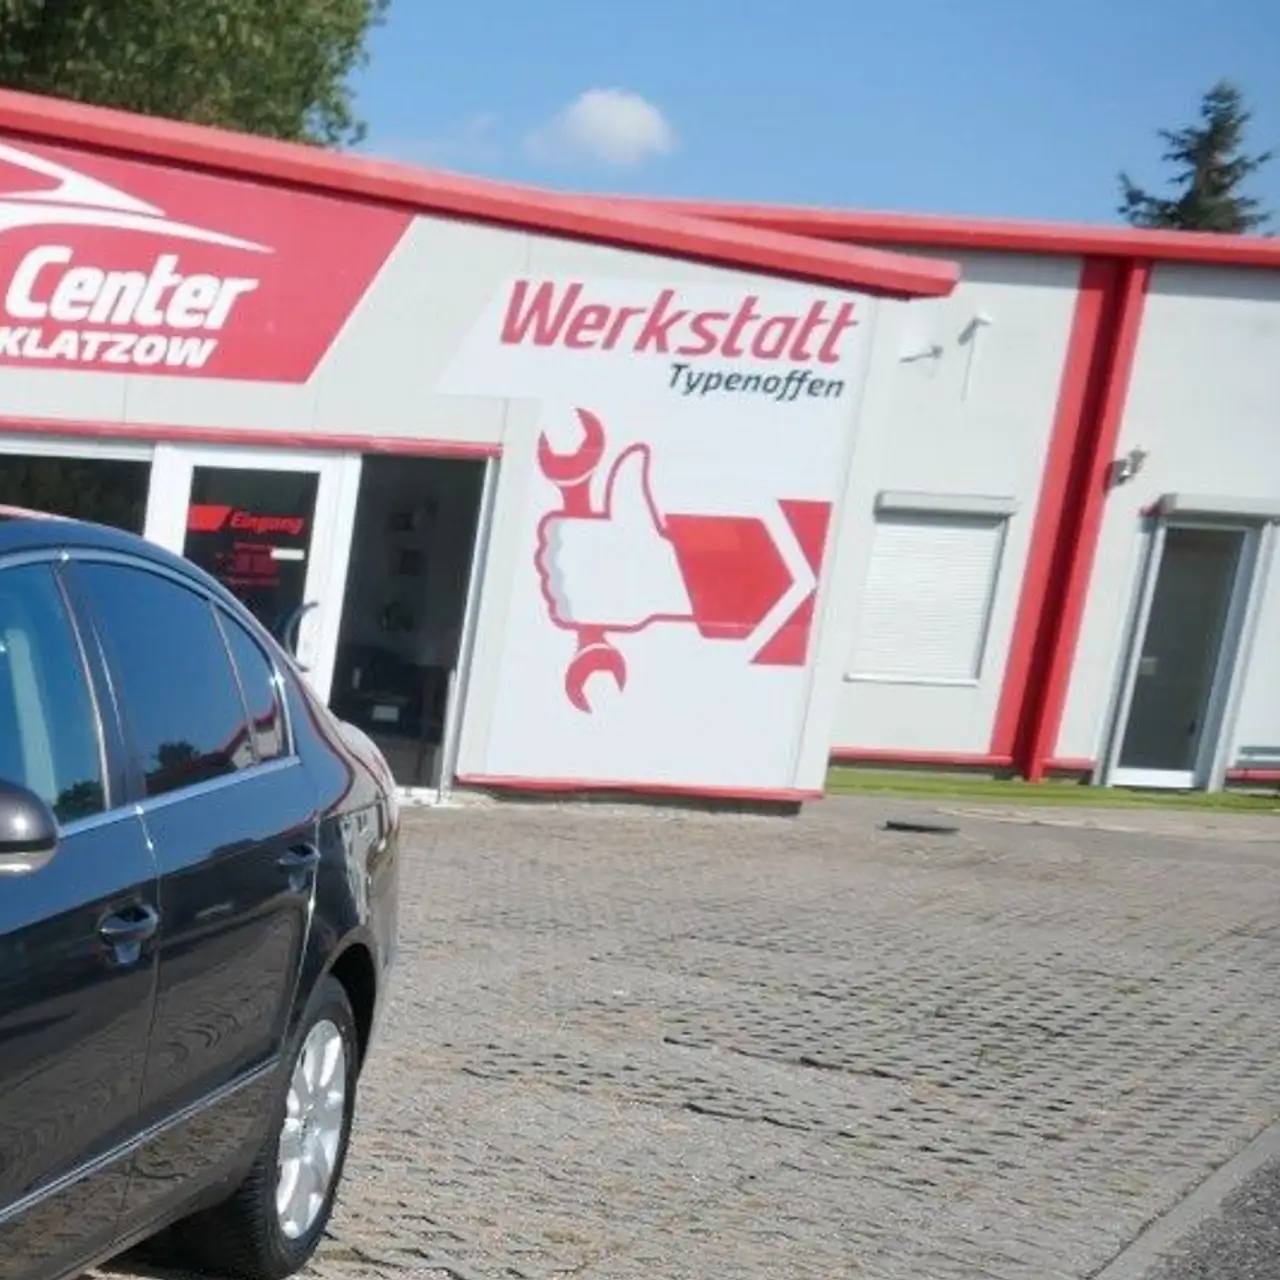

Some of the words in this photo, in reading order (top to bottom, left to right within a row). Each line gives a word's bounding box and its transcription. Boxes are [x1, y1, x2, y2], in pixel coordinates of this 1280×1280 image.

[5, 244, 260, 330] Center
[498, 279, 859, 364] Werkstatt
[667, 362, 846, 402] Typenoffen
[230, 510, 305, 535] Eingang
